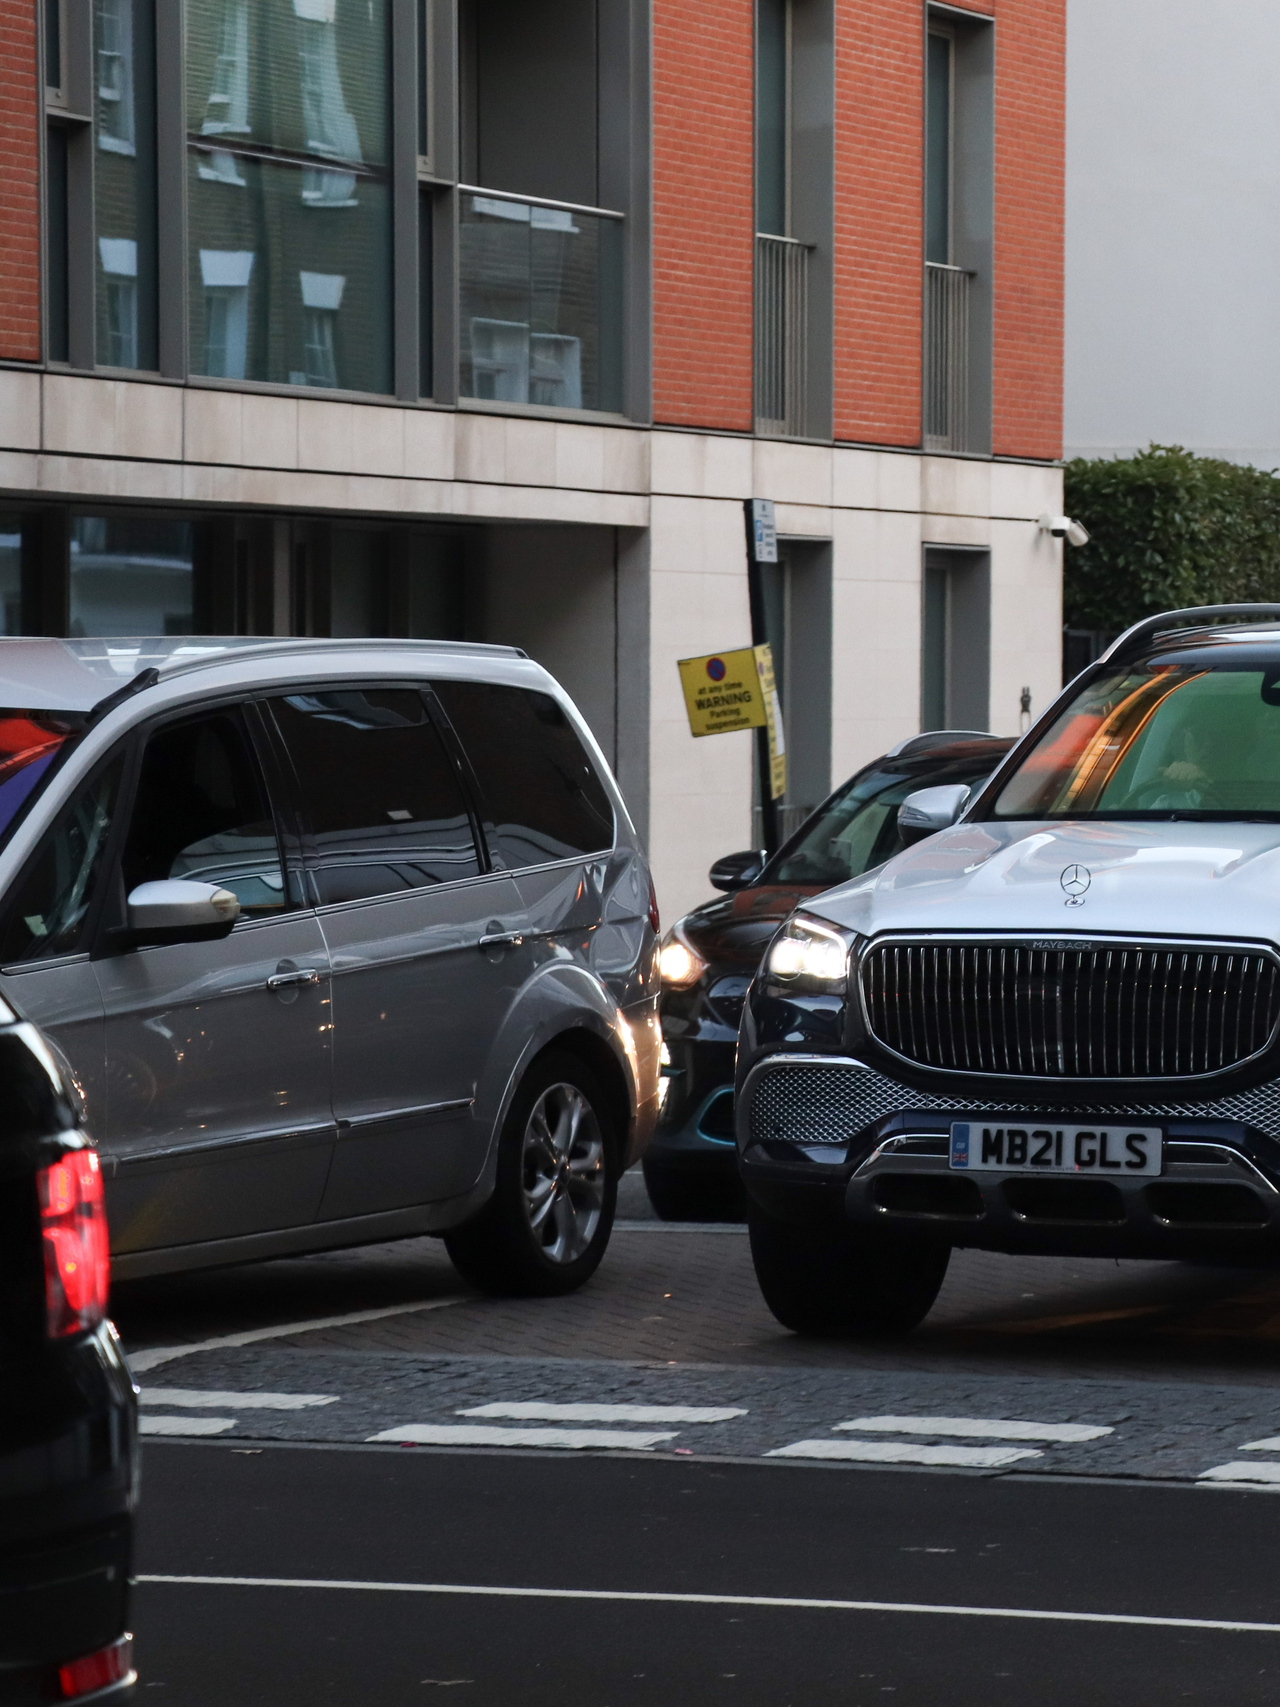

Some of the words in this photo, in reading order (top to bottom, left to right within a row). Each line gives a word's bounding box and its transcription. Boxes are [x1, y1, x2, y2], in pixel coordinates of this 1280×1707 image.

[698, 687, 706, 695] at
[708, 685, 722, 694] any
[695, 690, 752, 710] WARNING
[709, 708, 741, 718] Parking
[1032, 940, 1092, 950] MAYBACH
[981, 1128, 1064, 1167] MB21
[1074, 1131, 1148, 1169] GLS
